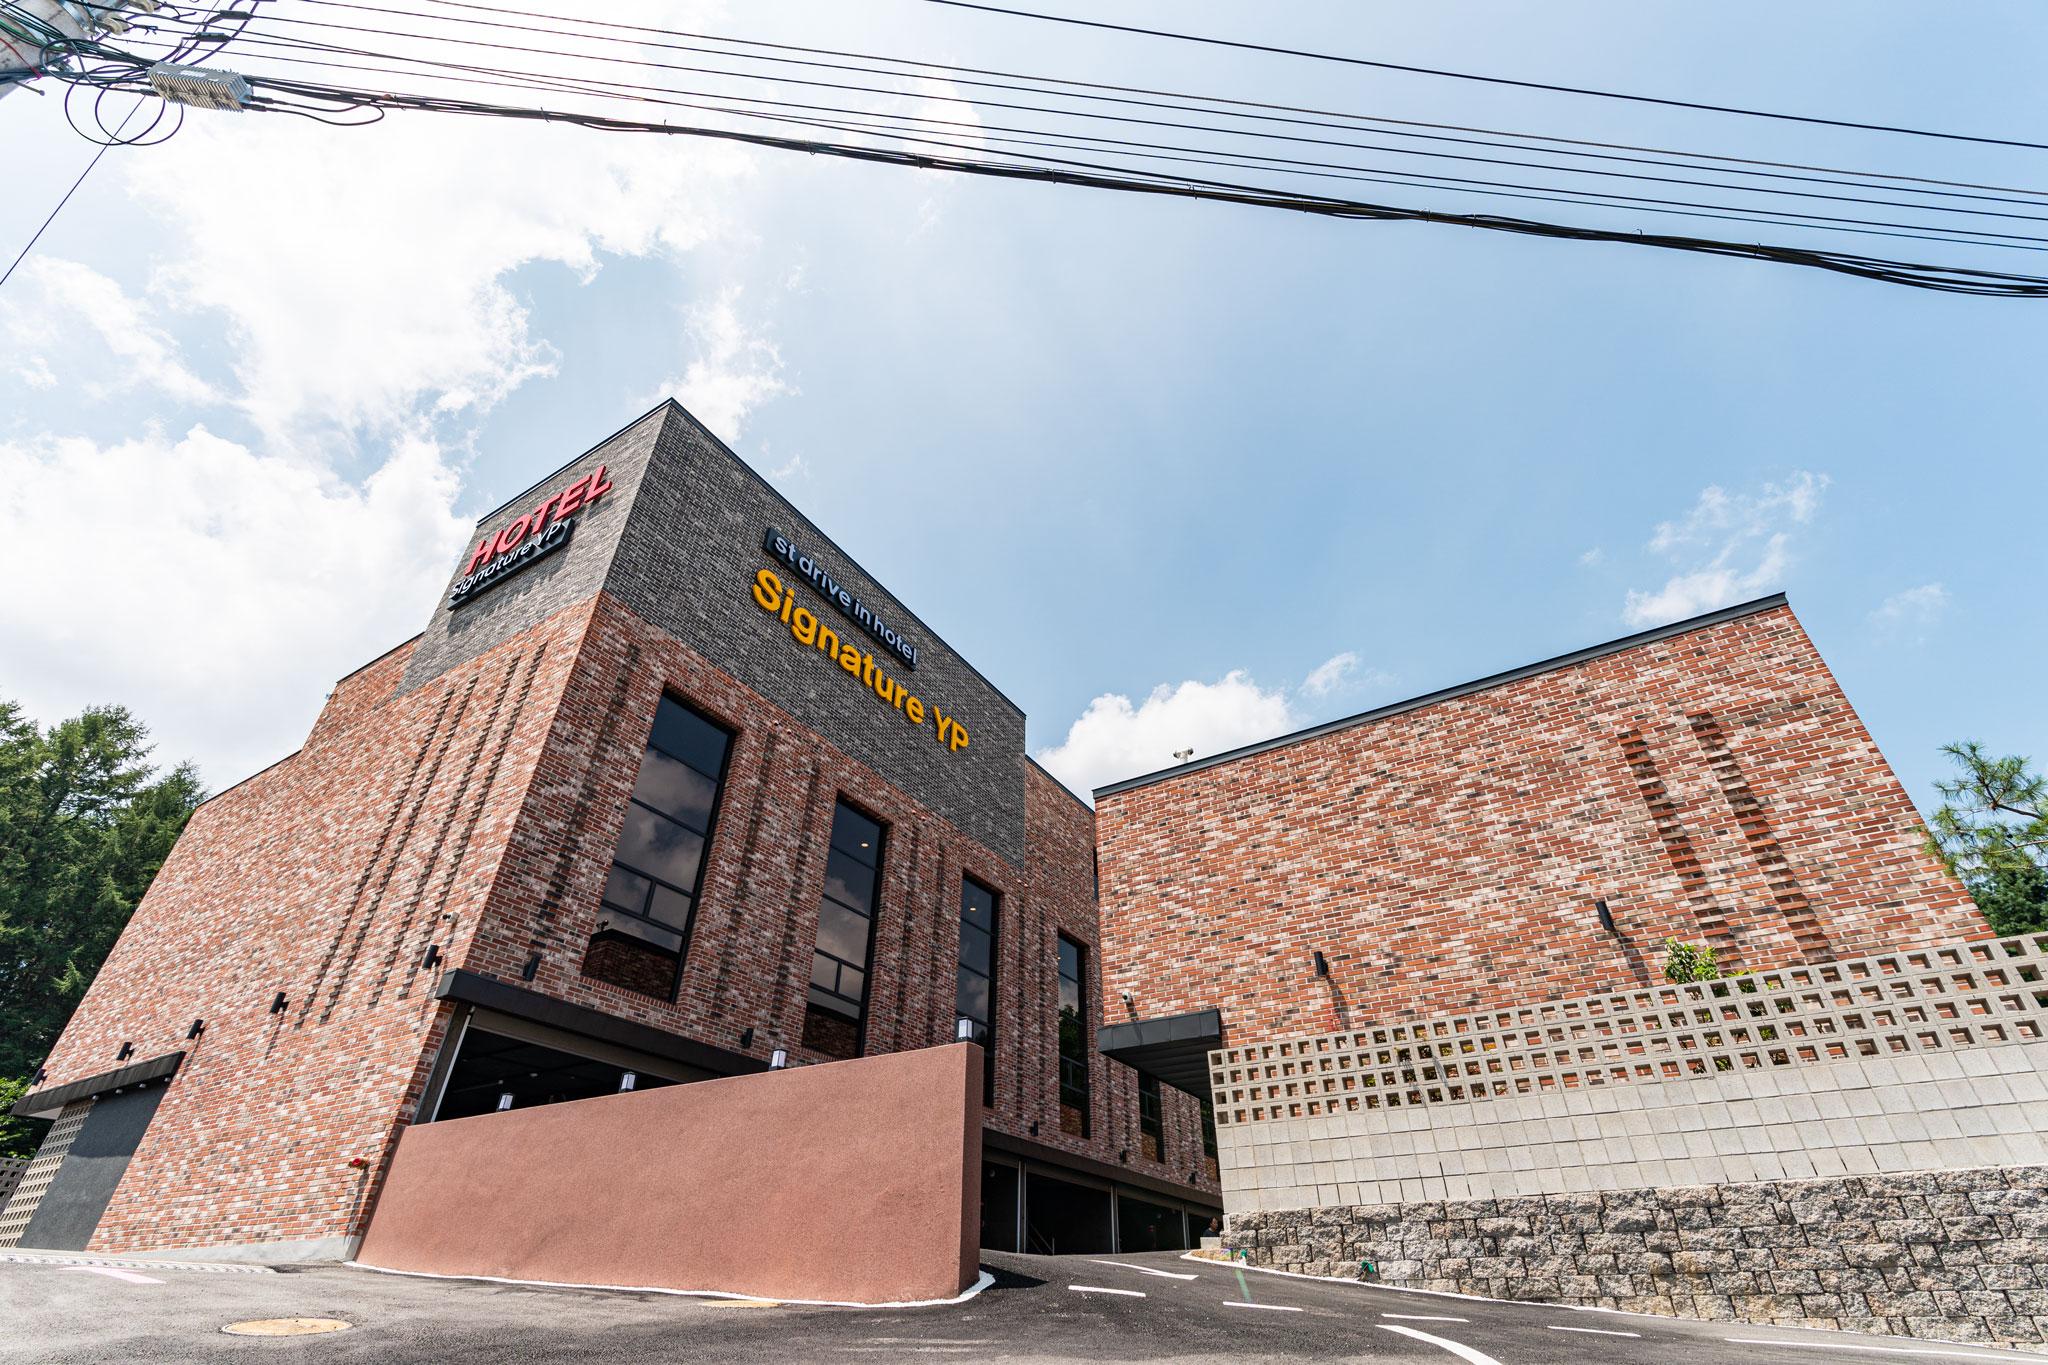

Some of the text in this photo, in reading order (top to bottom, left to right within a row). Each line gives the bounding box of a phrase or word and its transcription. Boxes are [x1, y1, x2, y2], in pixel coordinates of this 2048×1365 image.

[464, 465, 613, 577] HOTEL
[752, 568, 969, 752] Signature YP
[774, 536, 917, 664] st drive in hotel
